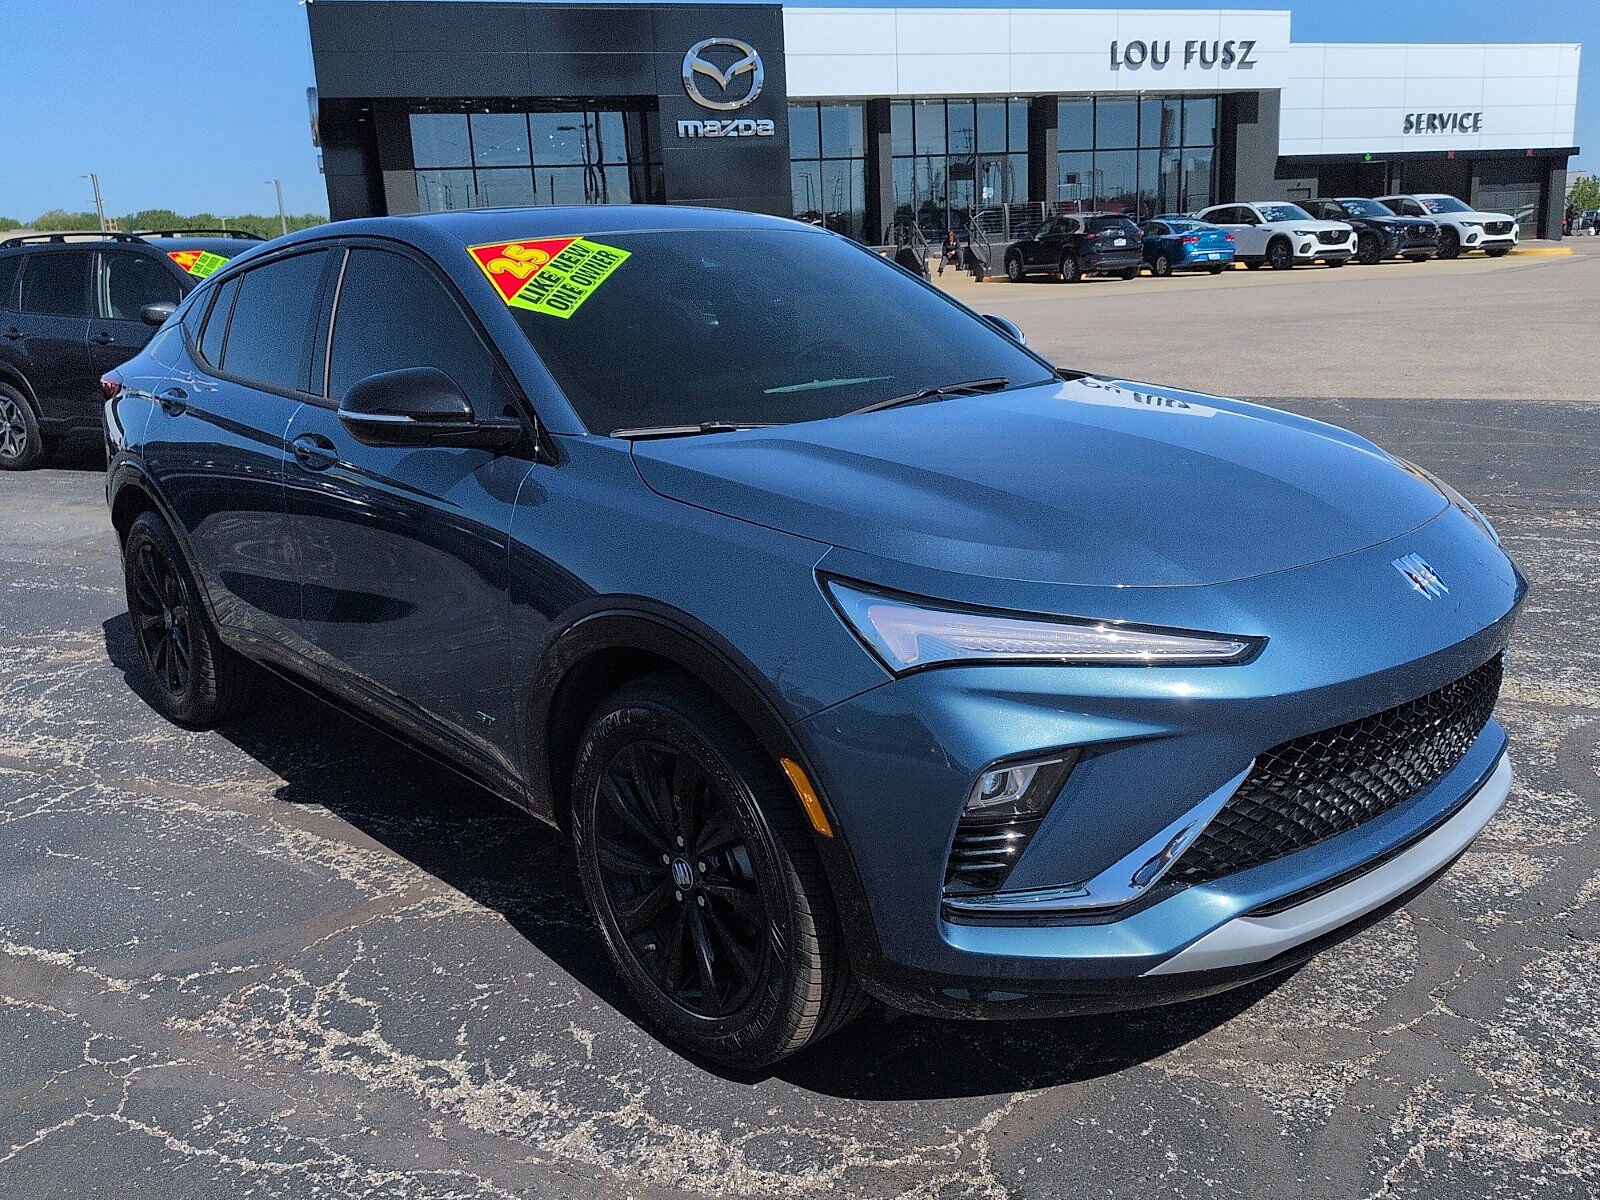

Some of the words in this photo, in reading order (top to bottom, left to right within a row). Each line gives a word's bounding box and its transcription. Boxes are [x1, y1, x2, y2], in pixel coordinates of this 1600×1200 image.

[1110, 40, 1171, 67] LOU
[1184, 40, 1258, 67] FUSZ
[1403, 112, 1483, 133] SERVICE
[487, 244, 550, 280] 25
[517, 271, 562, 305] LIKE
[551, 243, 592, 273] NEW
[545, 284, 585, 311] ONE
[570, 250, 620, 287] OWNER
